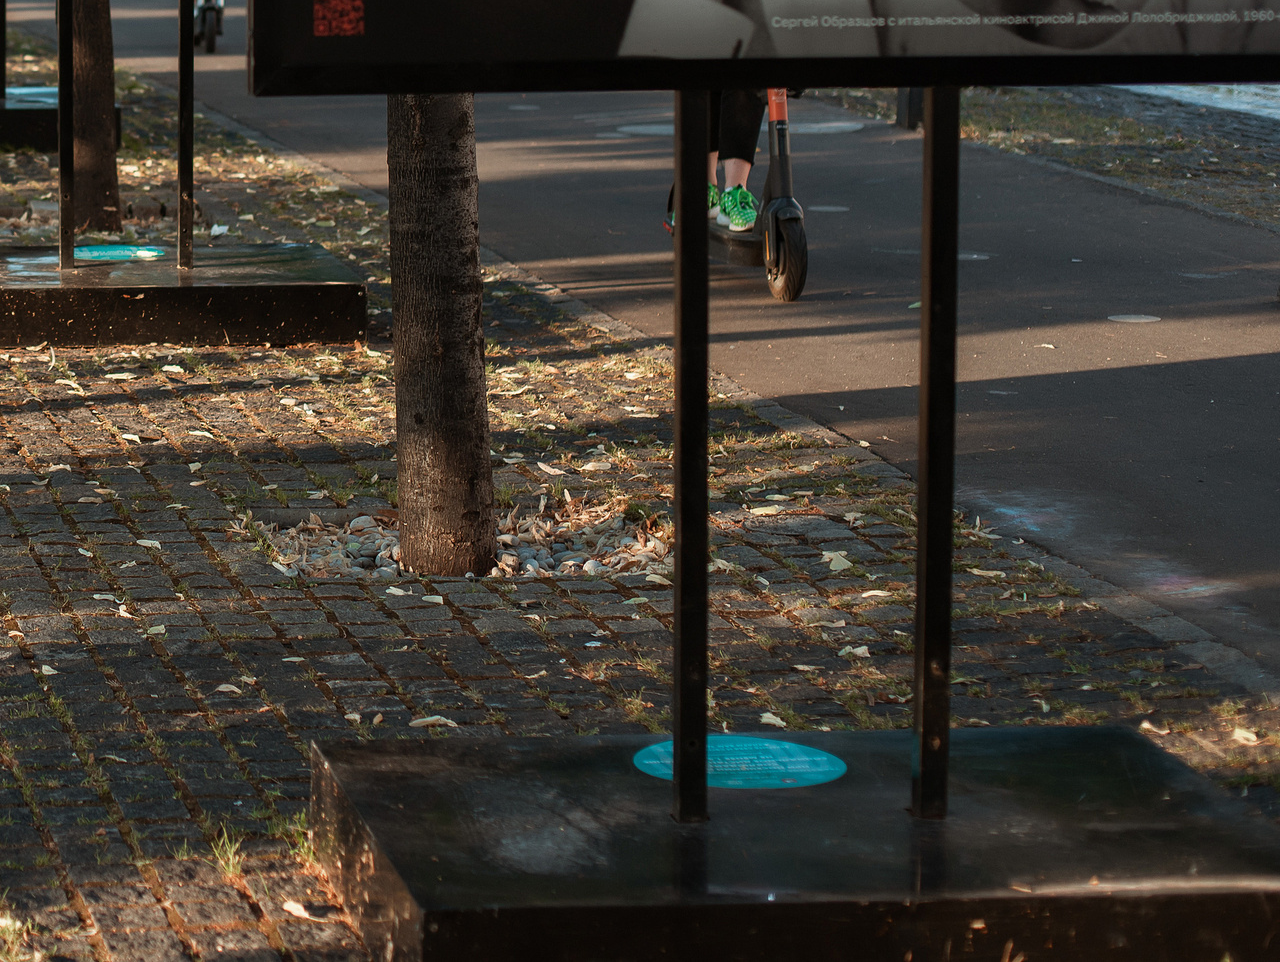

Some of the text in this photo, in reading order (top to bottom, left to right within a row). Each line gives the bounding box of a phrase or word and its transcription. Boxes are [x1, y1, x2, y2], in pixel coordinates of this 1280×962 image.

[771, 15, 818, 30] Сергей
[821, 15, 885, 29] Образцов
[887, 17, 896, 27] с
[898, 14, 980, 27] итальянской
[983, 12, 1074, 27] киноактрисой
[1077, 12, 1129, 25] Джиной
[1132, 11, 1240, 25] Лолобриджидой,
